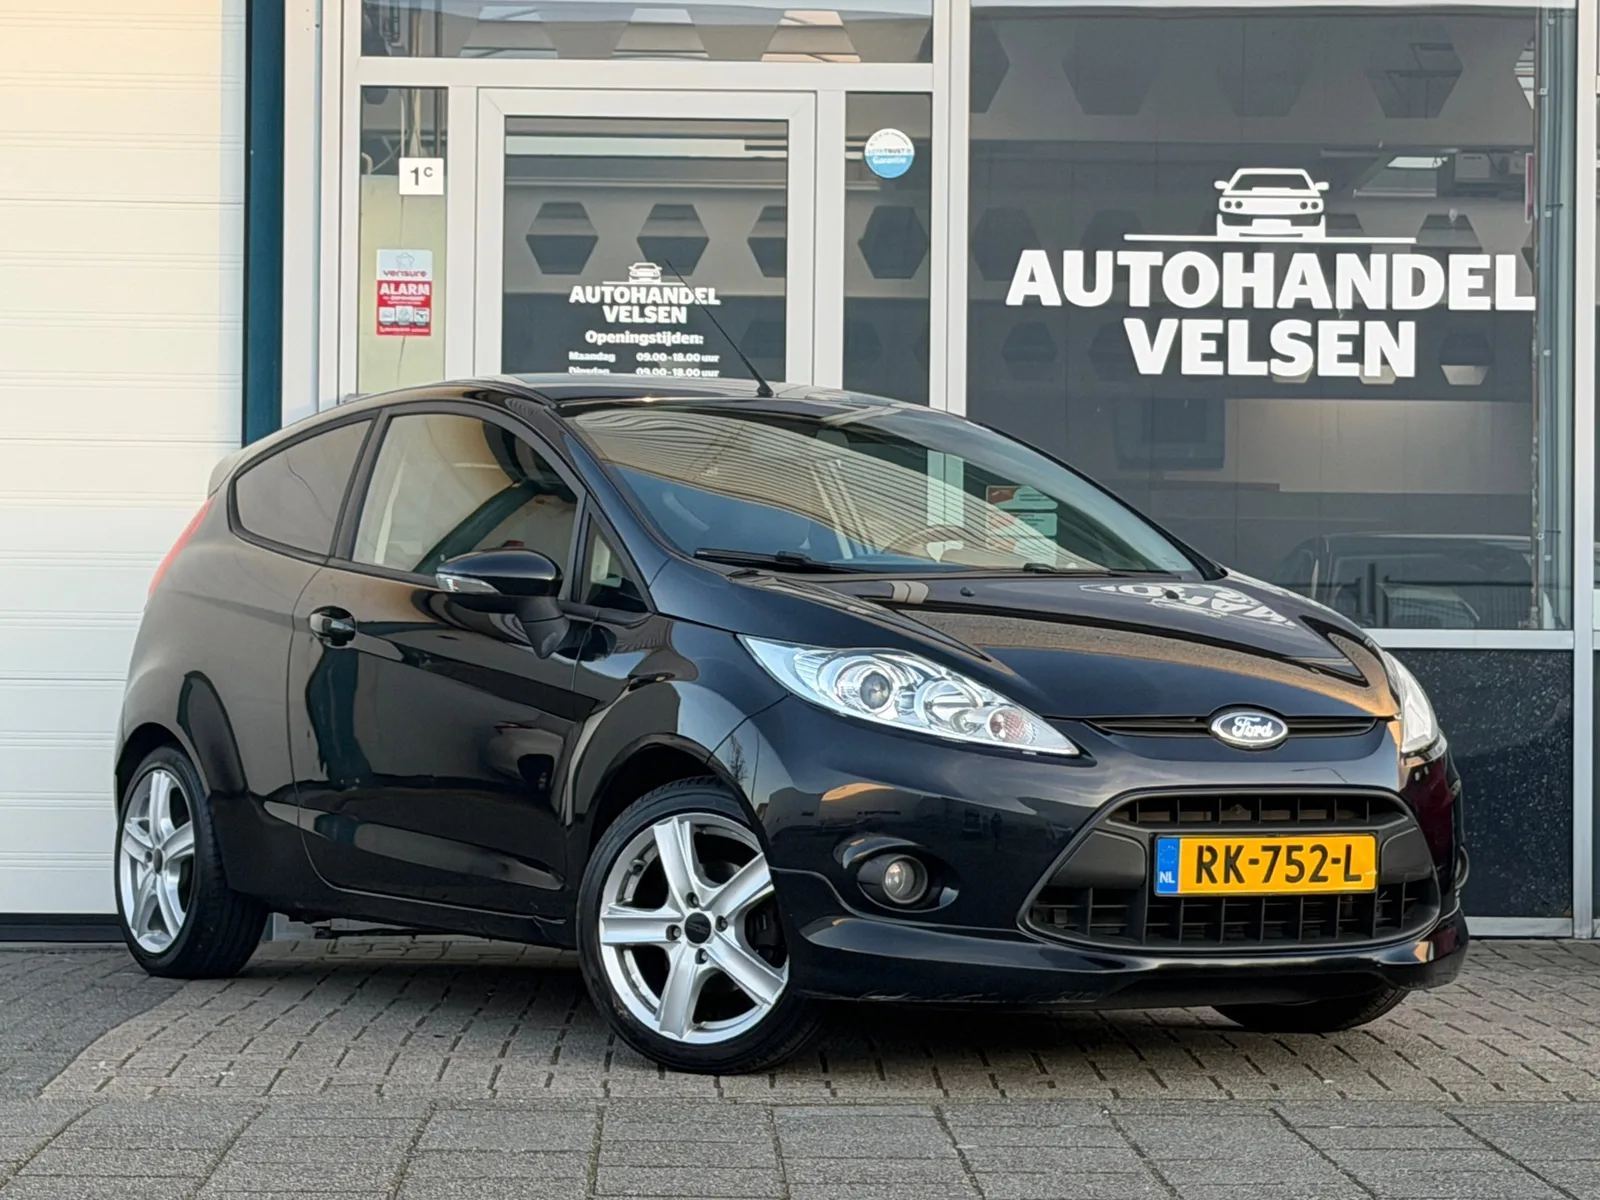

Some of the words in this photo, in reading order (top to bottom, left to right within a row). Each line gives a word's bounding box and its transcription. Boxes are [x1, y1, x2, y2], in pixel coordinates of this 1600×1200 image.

[379, 282, 430, 296] ALARM
[1006, 250, 1536, 311] AUTOHANDEL
[569, 286, 721, 305] AUTOHANDEL
[602, 305, 687, 324] VELSEN
[585, 330, 704, 346] Openingstijden:
[568, 351, 616, 363] Maandag
[701, 354, 720, 363] uur
[1123, 318, 1416, 378] VELSEN
[1232, 716, 1273, 738] Ford
[1196, 844, 1362, 885] RK-752-L
[1159, 871, 1175, 884] NL
